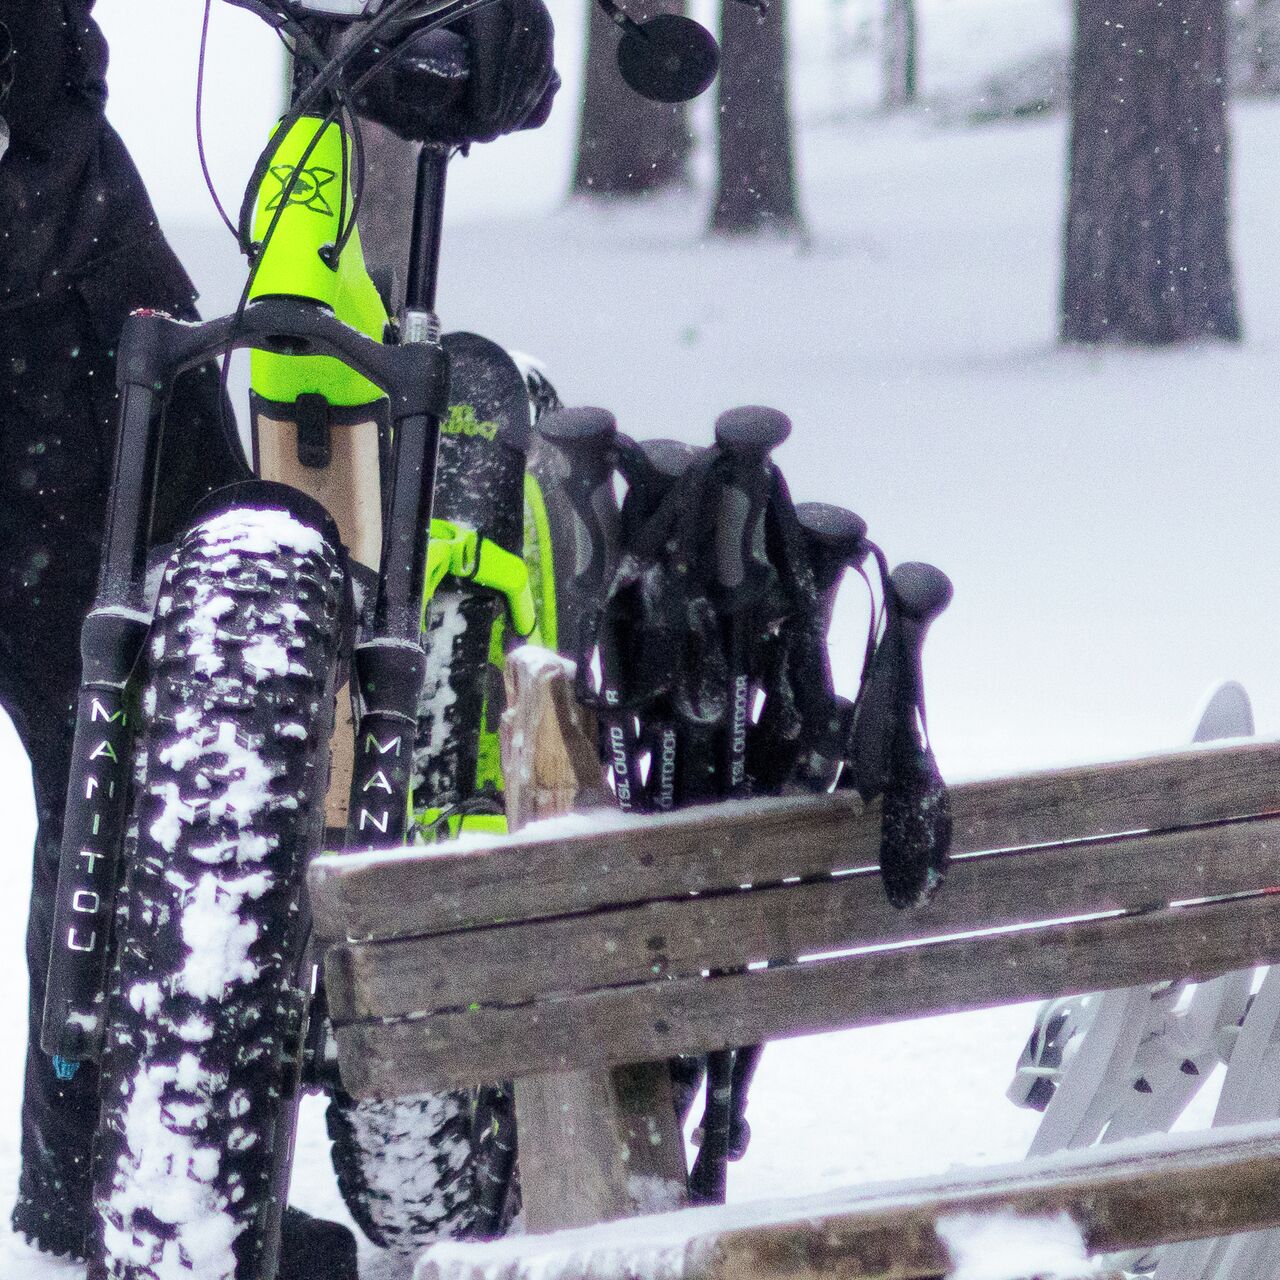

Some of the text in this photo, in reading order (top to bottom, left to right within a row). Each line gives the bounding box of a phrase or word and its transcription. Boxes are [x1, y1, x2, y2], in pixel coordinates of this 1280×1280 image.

[67, 696, 126, 952] MANITOU
[359, 732, 402, 852] MAN
[617, 779, 632, 810] TSL
